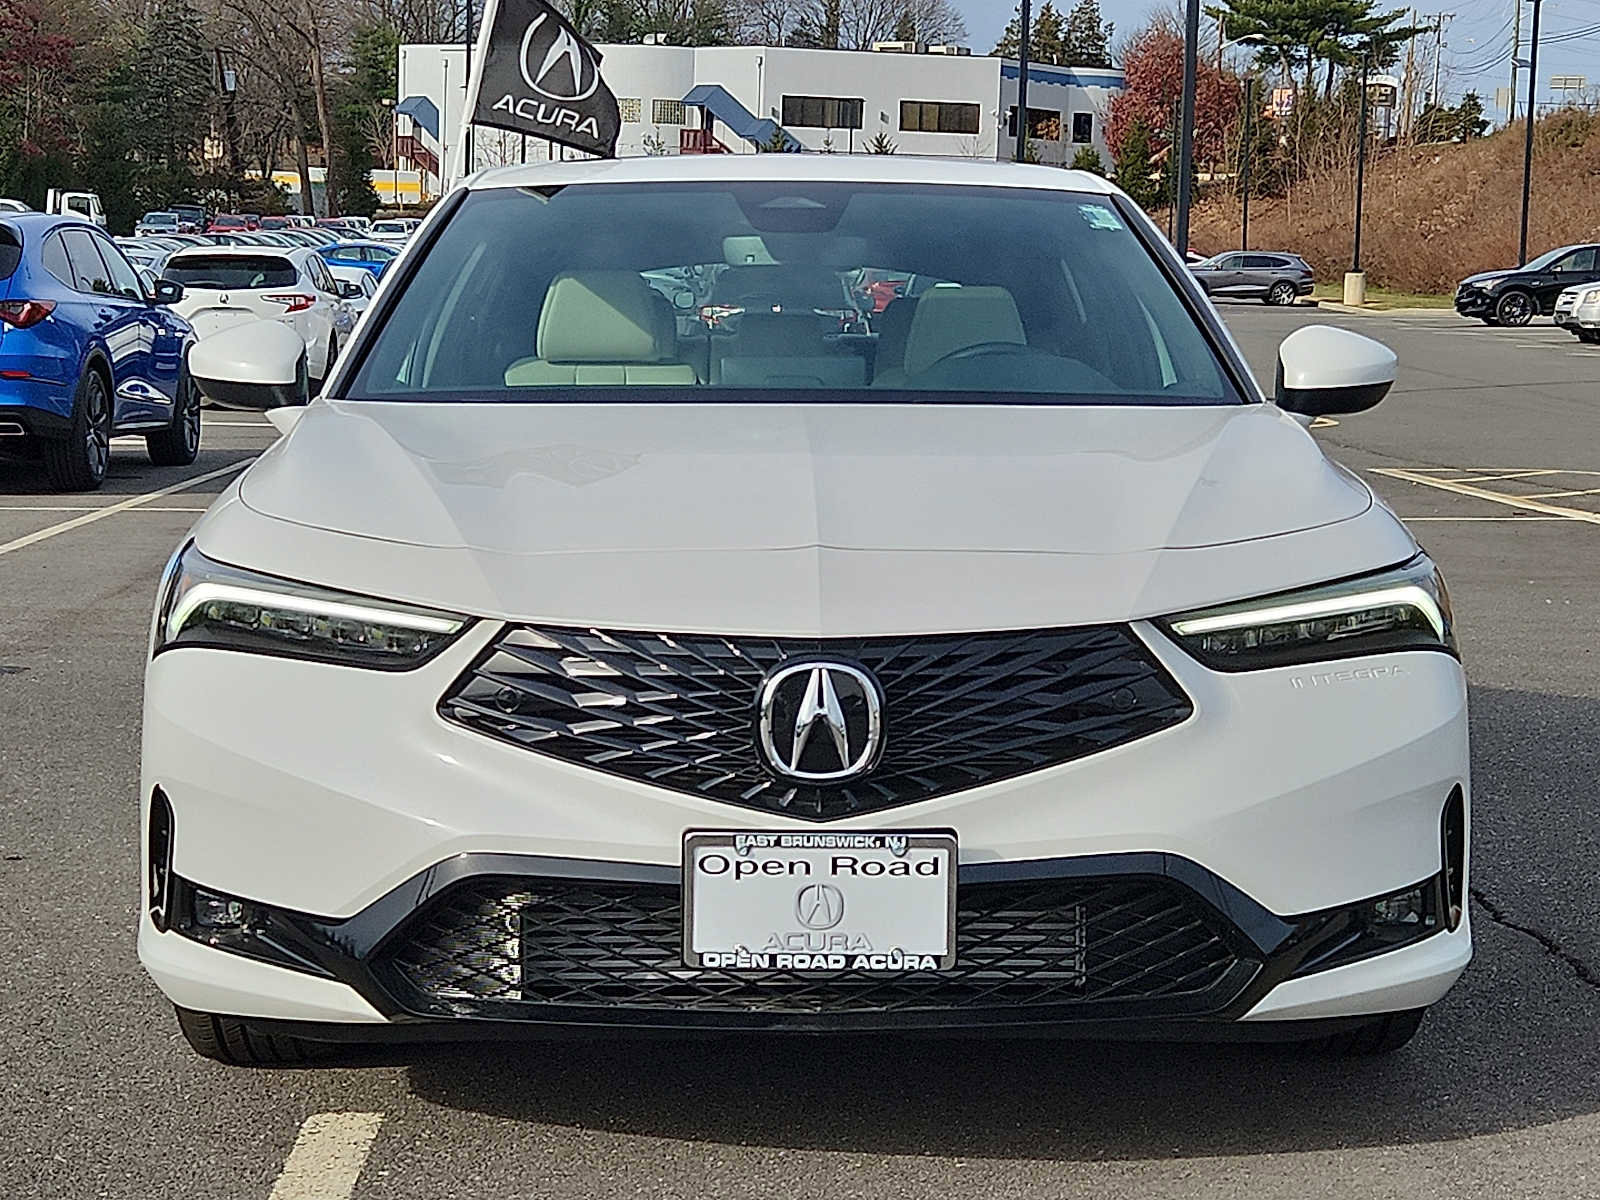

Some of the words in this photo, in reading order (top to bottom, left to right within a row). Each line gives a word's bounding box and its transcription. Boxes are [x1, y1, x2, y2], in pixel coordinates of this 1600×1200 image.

[492, 94, 599, 140] ACURA
[735, 835, 778, 849] EAST
[884, 836, 907, 849] NJ
[698, 854, 811, 880] Open
[831, 855, 940, 876] Road
[761, 932, 875, 952] ACURA
[702, 952, 770, 969] OPEN
[776, 953, 847, 970] ROAD
[851, 954, 938, 971] ACURA
